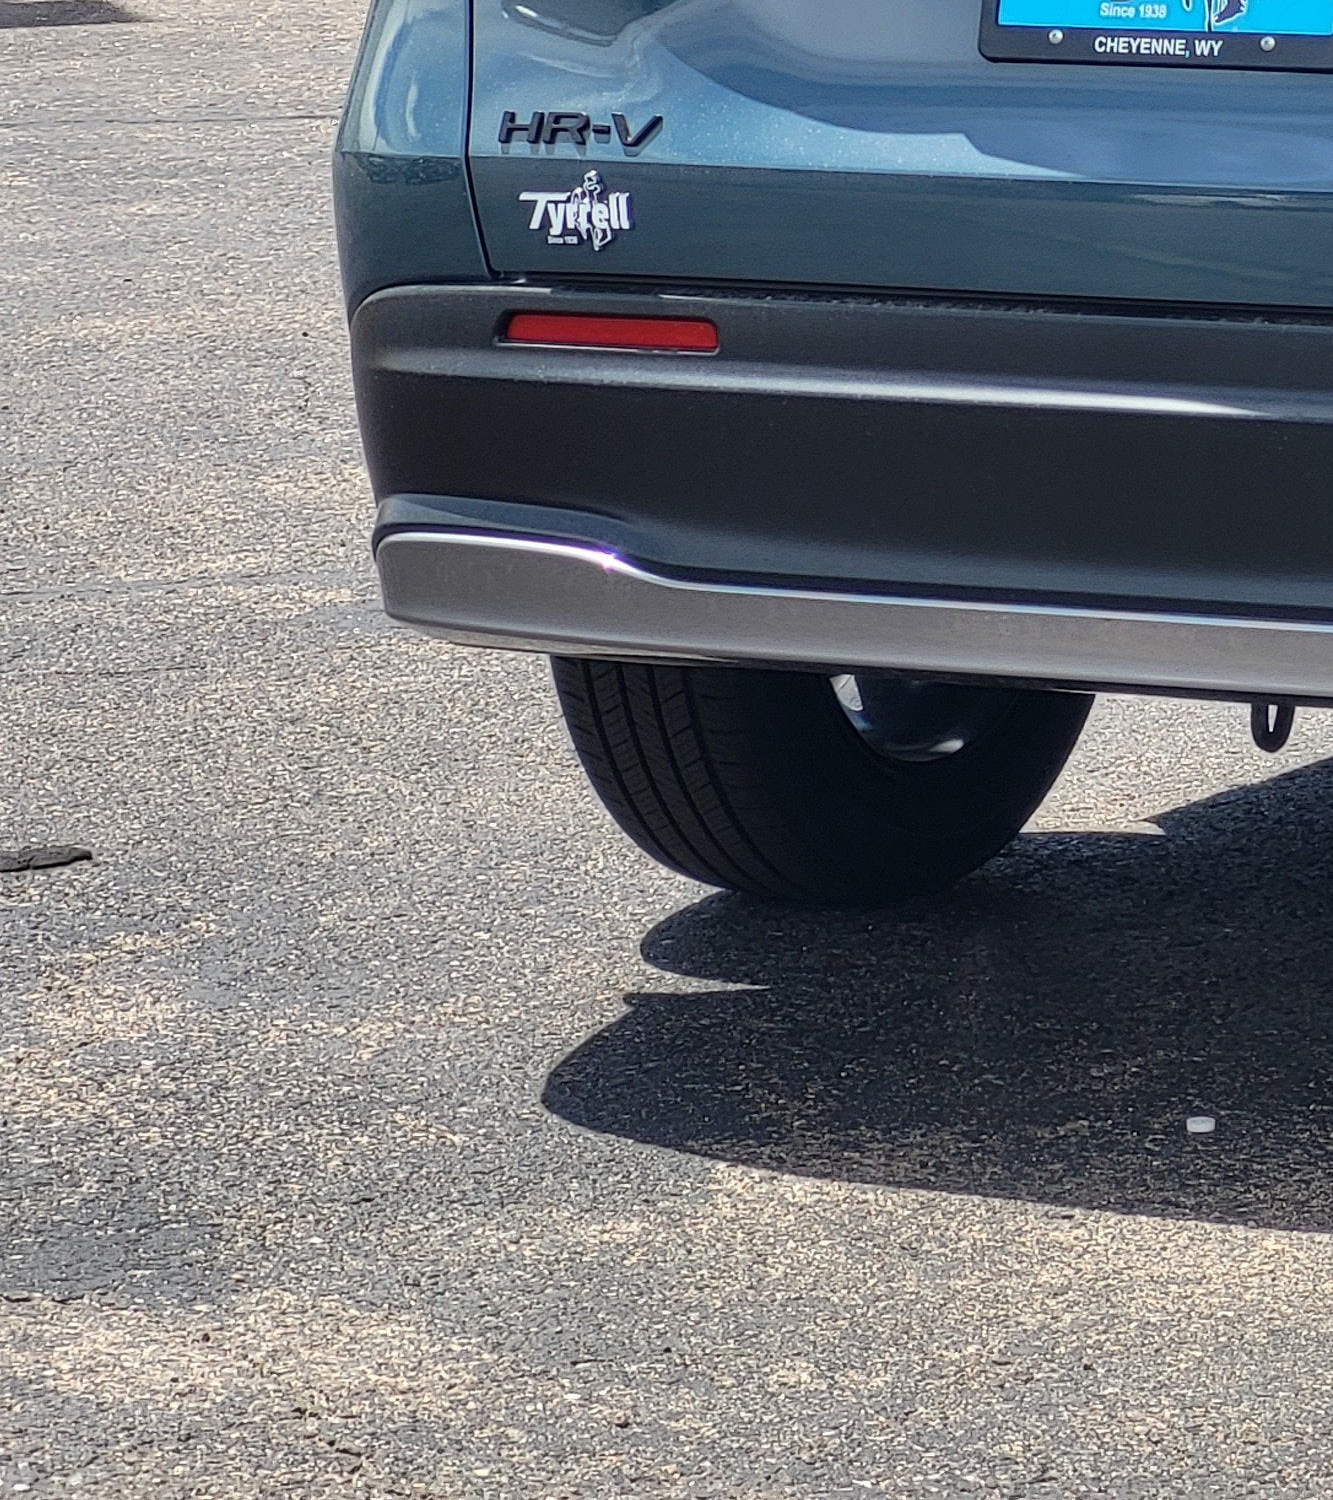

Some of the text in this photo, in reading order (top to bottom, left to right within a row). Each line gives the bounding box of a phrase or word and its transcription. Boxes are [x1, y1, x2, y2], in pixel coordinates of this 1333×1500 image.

[1099, 2, 1168, 20] Since 1938
[1093, 35, 1224, 57] CHEYENNE, WY
[497, 110, 664, 148] HR-V
[518, 190, 632, 236] Tyrrell
